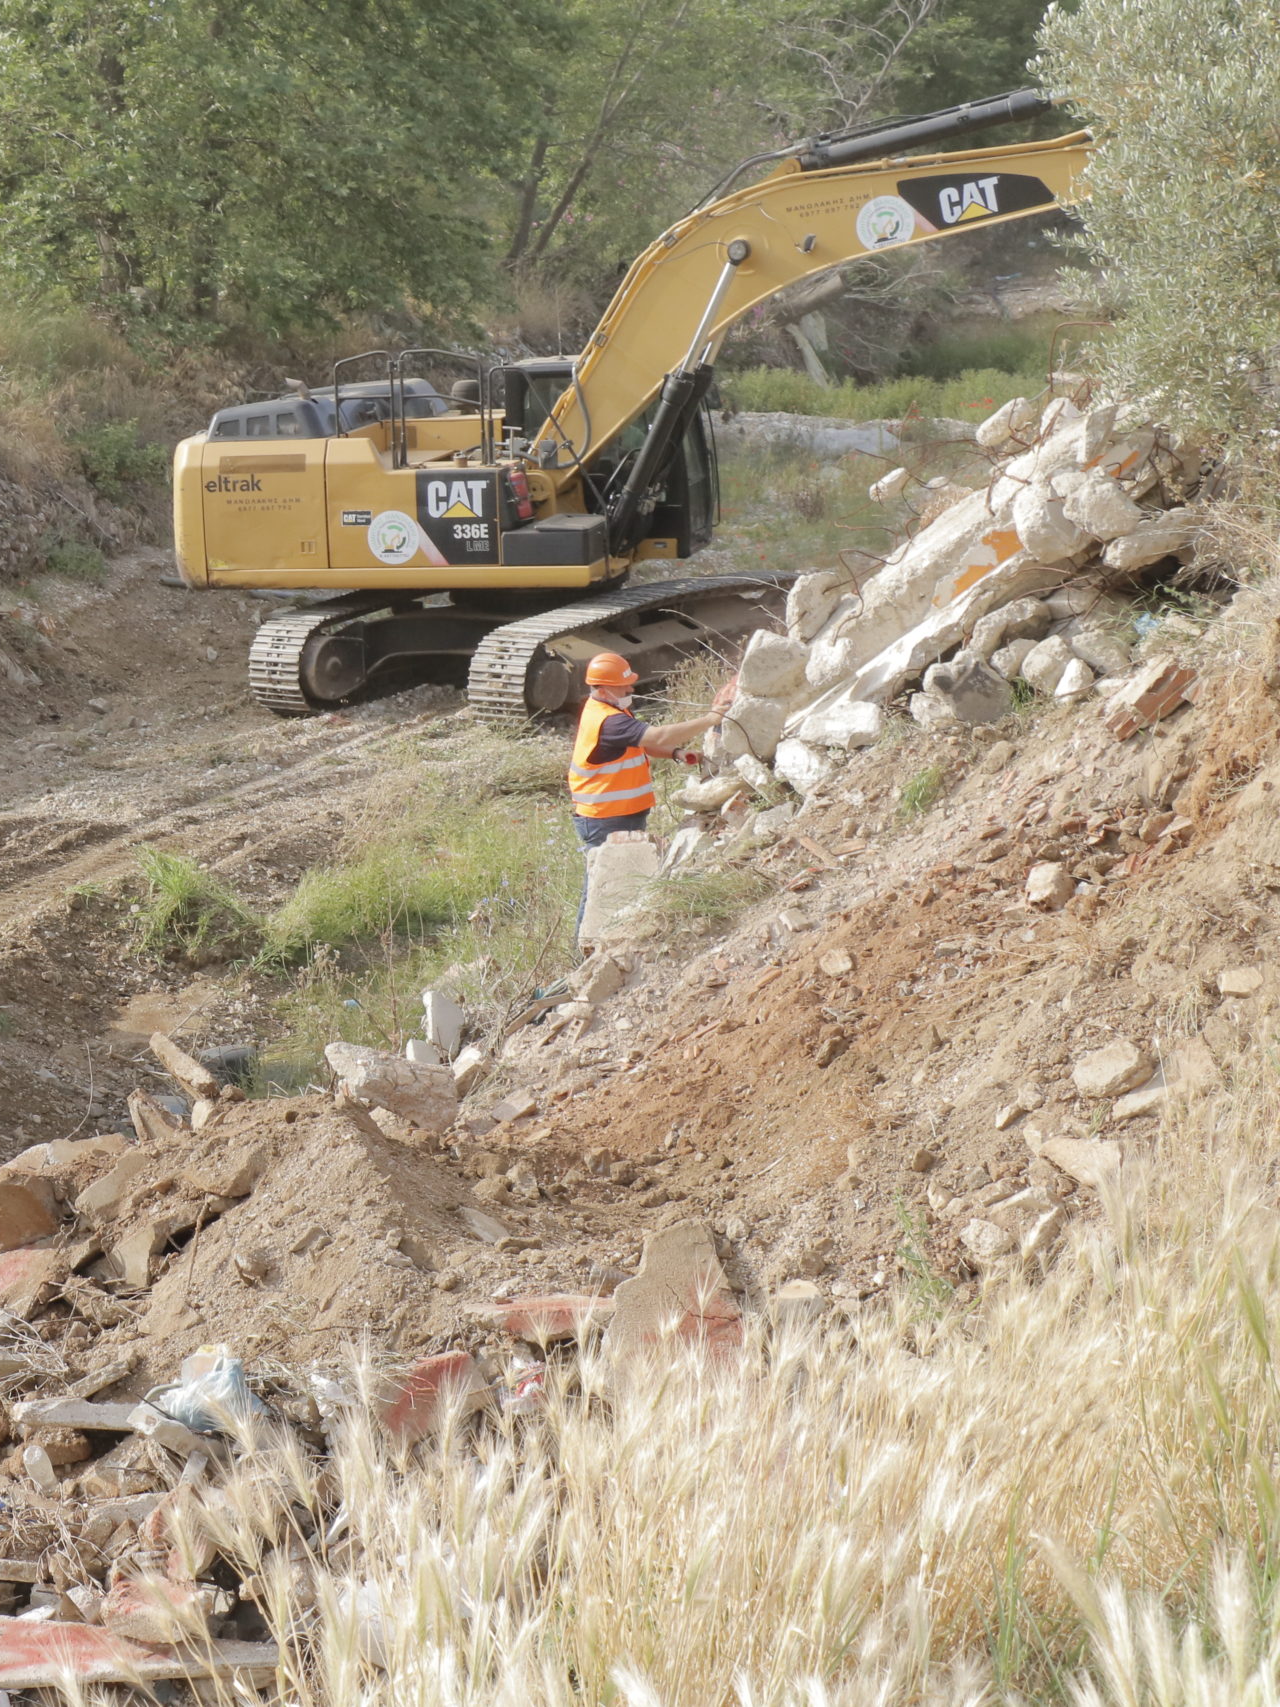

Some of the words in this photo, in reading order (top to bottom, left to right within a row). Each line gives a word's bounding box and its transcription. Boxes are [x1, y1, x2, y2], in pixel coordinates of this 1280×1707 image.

[939, 176, 999, 224] CAT
[205, 474, 262, 492] eltrak
[427, 480, 487, 518] CAT
[453, 523, 489, 539] 336E
